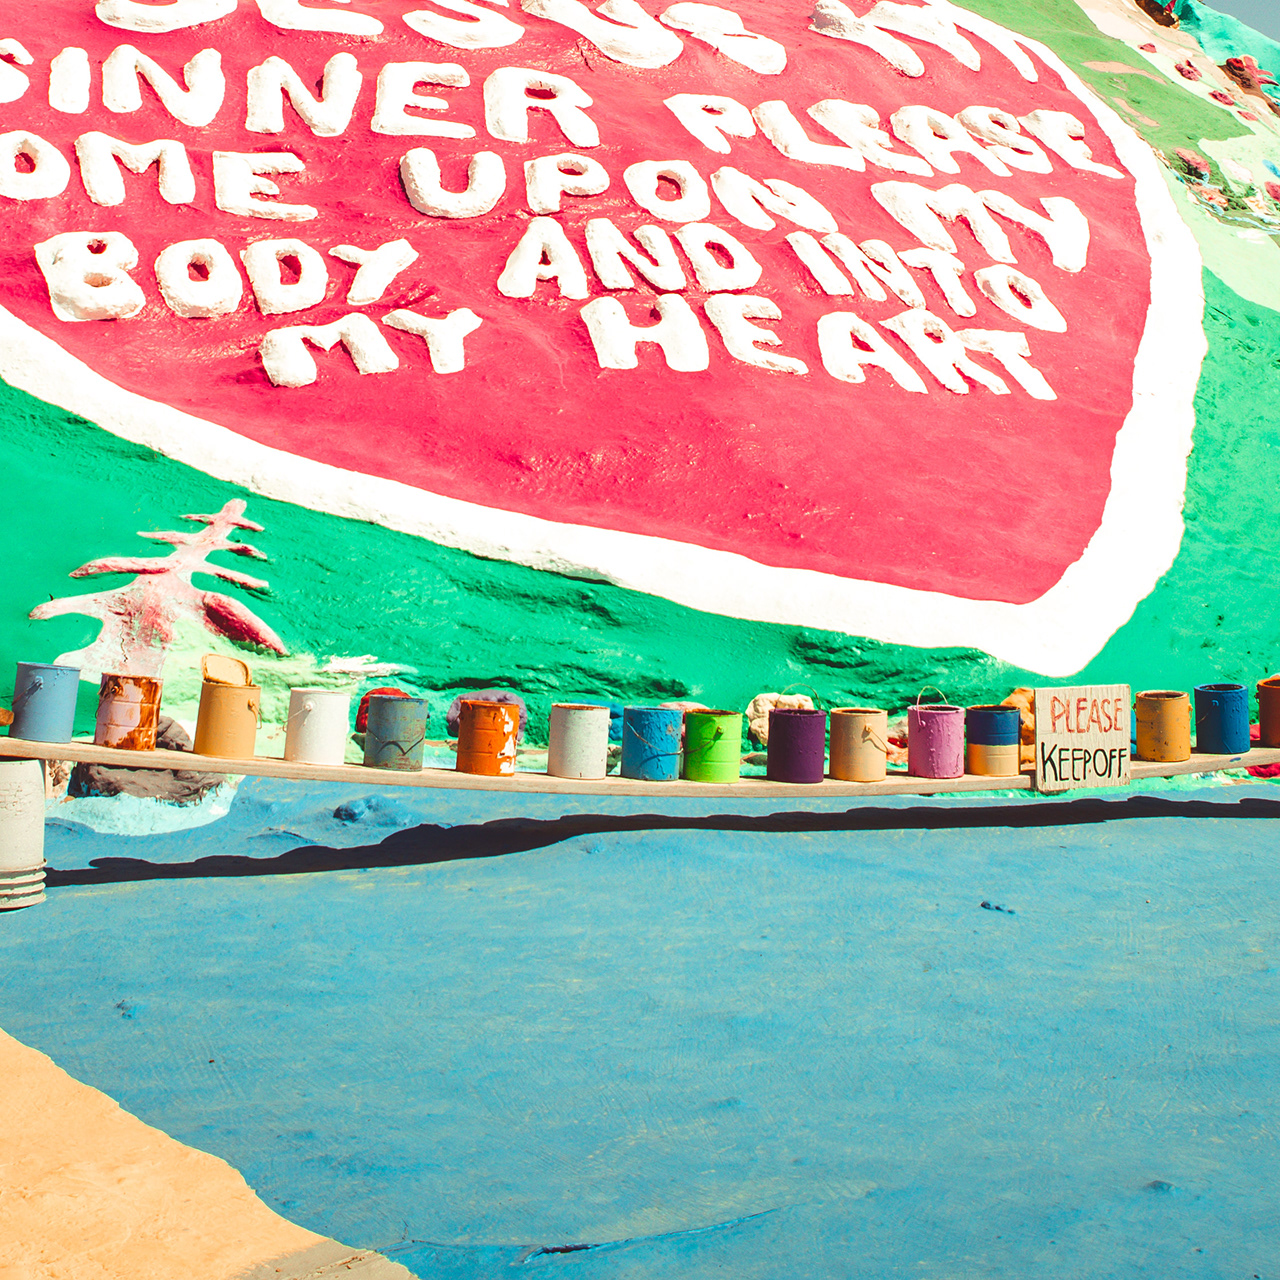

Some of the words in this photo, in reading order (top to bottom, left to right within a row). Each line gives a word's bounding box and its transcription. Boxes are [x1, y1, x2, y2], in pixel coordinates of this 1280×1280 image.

[662, 92, 1125, 179] PLEASE
[399, 146, 839, 233] UPON
[870, 180, 1091, 273] MY
[33, 230, 420, 323] BODY
[496, 217, 763, 301] AND
[785, 231, 1068, 333] INTO
[259, 307, 484, 388] MY
[579, 291, 1058, 401] HEART
[1050, 696, 1123, 734] PLEASE
